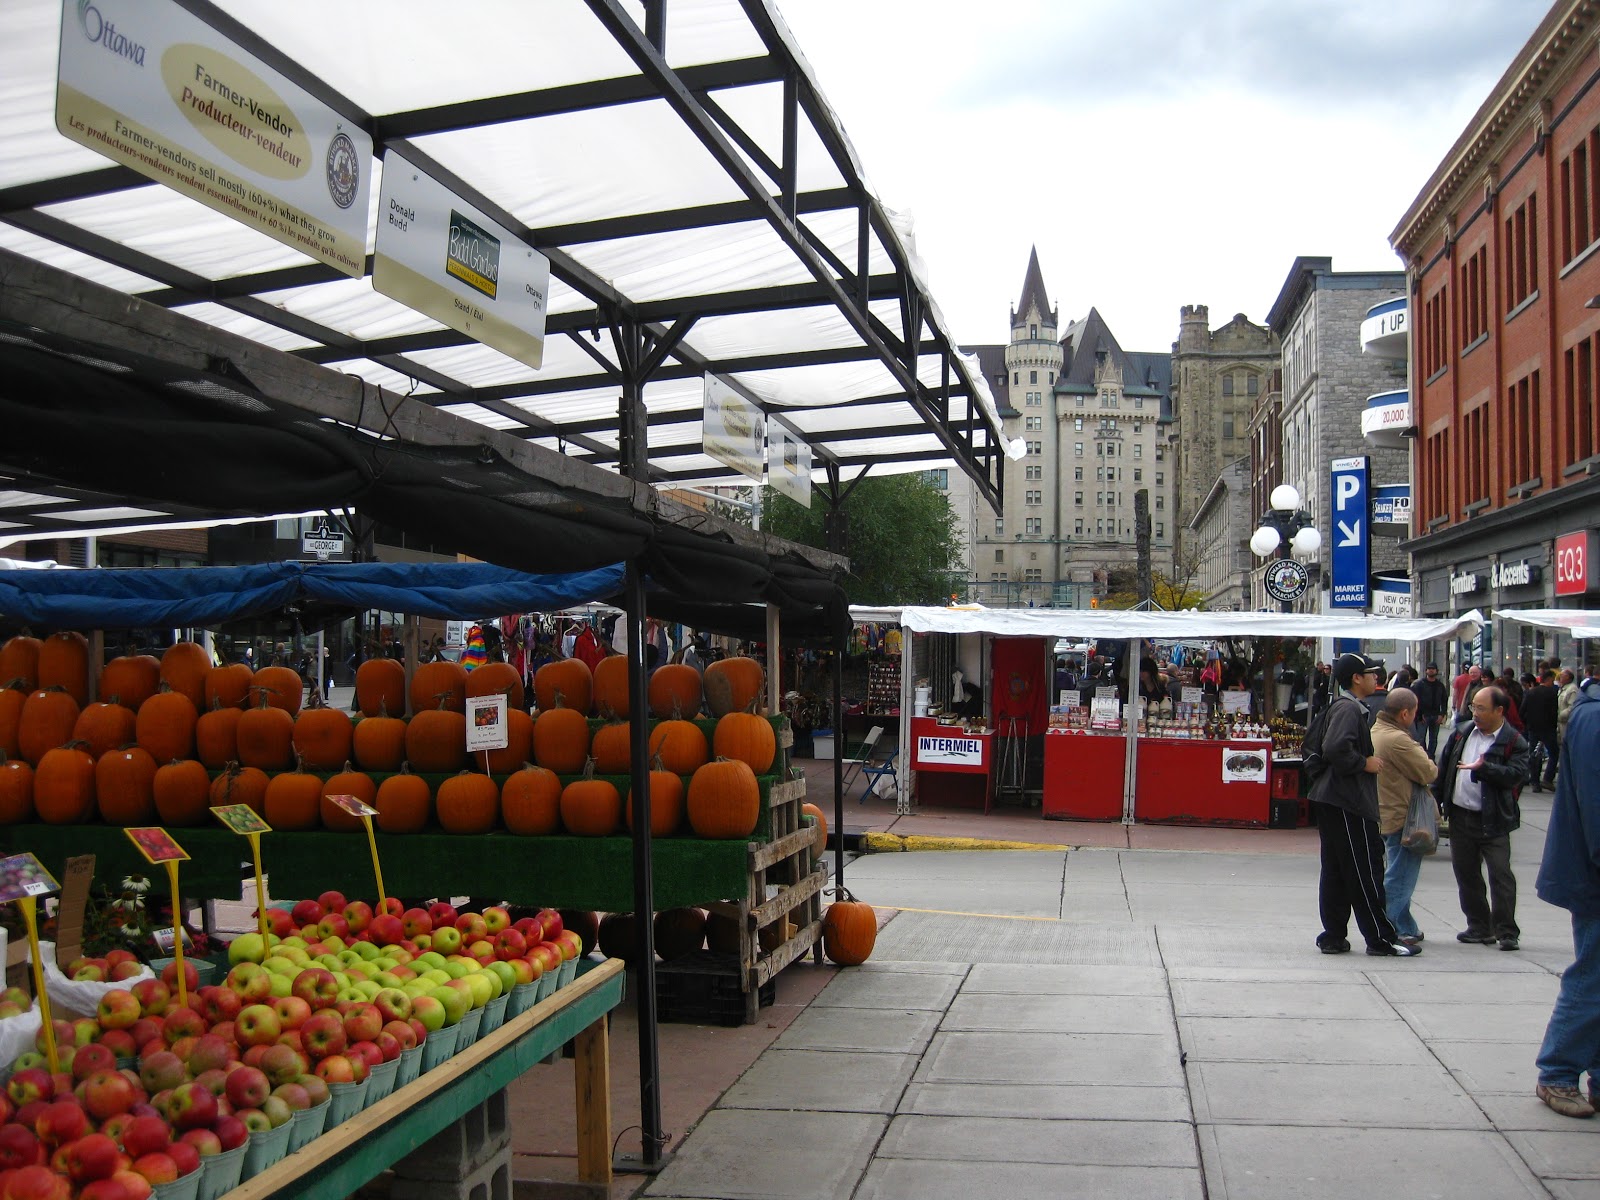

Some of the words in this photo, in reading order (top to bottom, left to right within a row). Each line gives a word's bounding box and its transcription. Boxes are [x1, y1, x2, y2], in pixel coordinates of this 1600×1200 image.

[84, 5, 146, 67] Ottawa
[195, 63, 293, 138] Farmer-Vendor
[181, 86, 302, 168] Producteur-vendeur
[69, 115, 85, 132] Les
[87, 126, 175, 177] producteurs-vendeurs
[176, 172, 206, 192] vendent
[207, 186, 258, 219] essentiellement
[268, 217, 278, 229] 60
[287, 226, 296, 238] les
[297, 234, 321, 251] produits
[321, 246, 337, 259] qu'ils
[114, 119, 197, 172] Farmer-vendors
[199, 166, 216, 182] sell
[218, 176, 247, 199] mostly
[248, 191, 278, 215] (60+%)
[280, 208, 299, 225] what
[300, 216, 316, 236] they
[318, 228, 337, 244] grow
[390, 198, 415, 222] Donald
[389, 213, 408, 232] Budd
[449, 225, 470, 265] Budd
[470, 238, 498, 282] Gardens
[448, 261, 474, 281] PERENNIALS
[525, 283, 543, 301] Ottawa
[454, 298, 470, 314] Stand
[1390, 313, 1405, 331] UP
[1383, 409, 1405, 424] 20,000
[1336, 474, 1360, 512] P
[314, 540, 335, 550] GEORGE
[1287, 562, 1306, 580] MARKET
[1557, 545, 1584, 582] EQ3
[1450, 570, 1476, 595] Furniture
[1491, 565, 1499, 588] &
[1499, 560, 1530, 587] Accents
[1334, 584, 1365, 593] MARKET
[1334, 593, 1366, 602] GARAGE
[1378, 604, 1394, 614] LOOK
[1383, 595, 1397, 604] NEW
[919, 737, 980, 753] INTERMIEL
